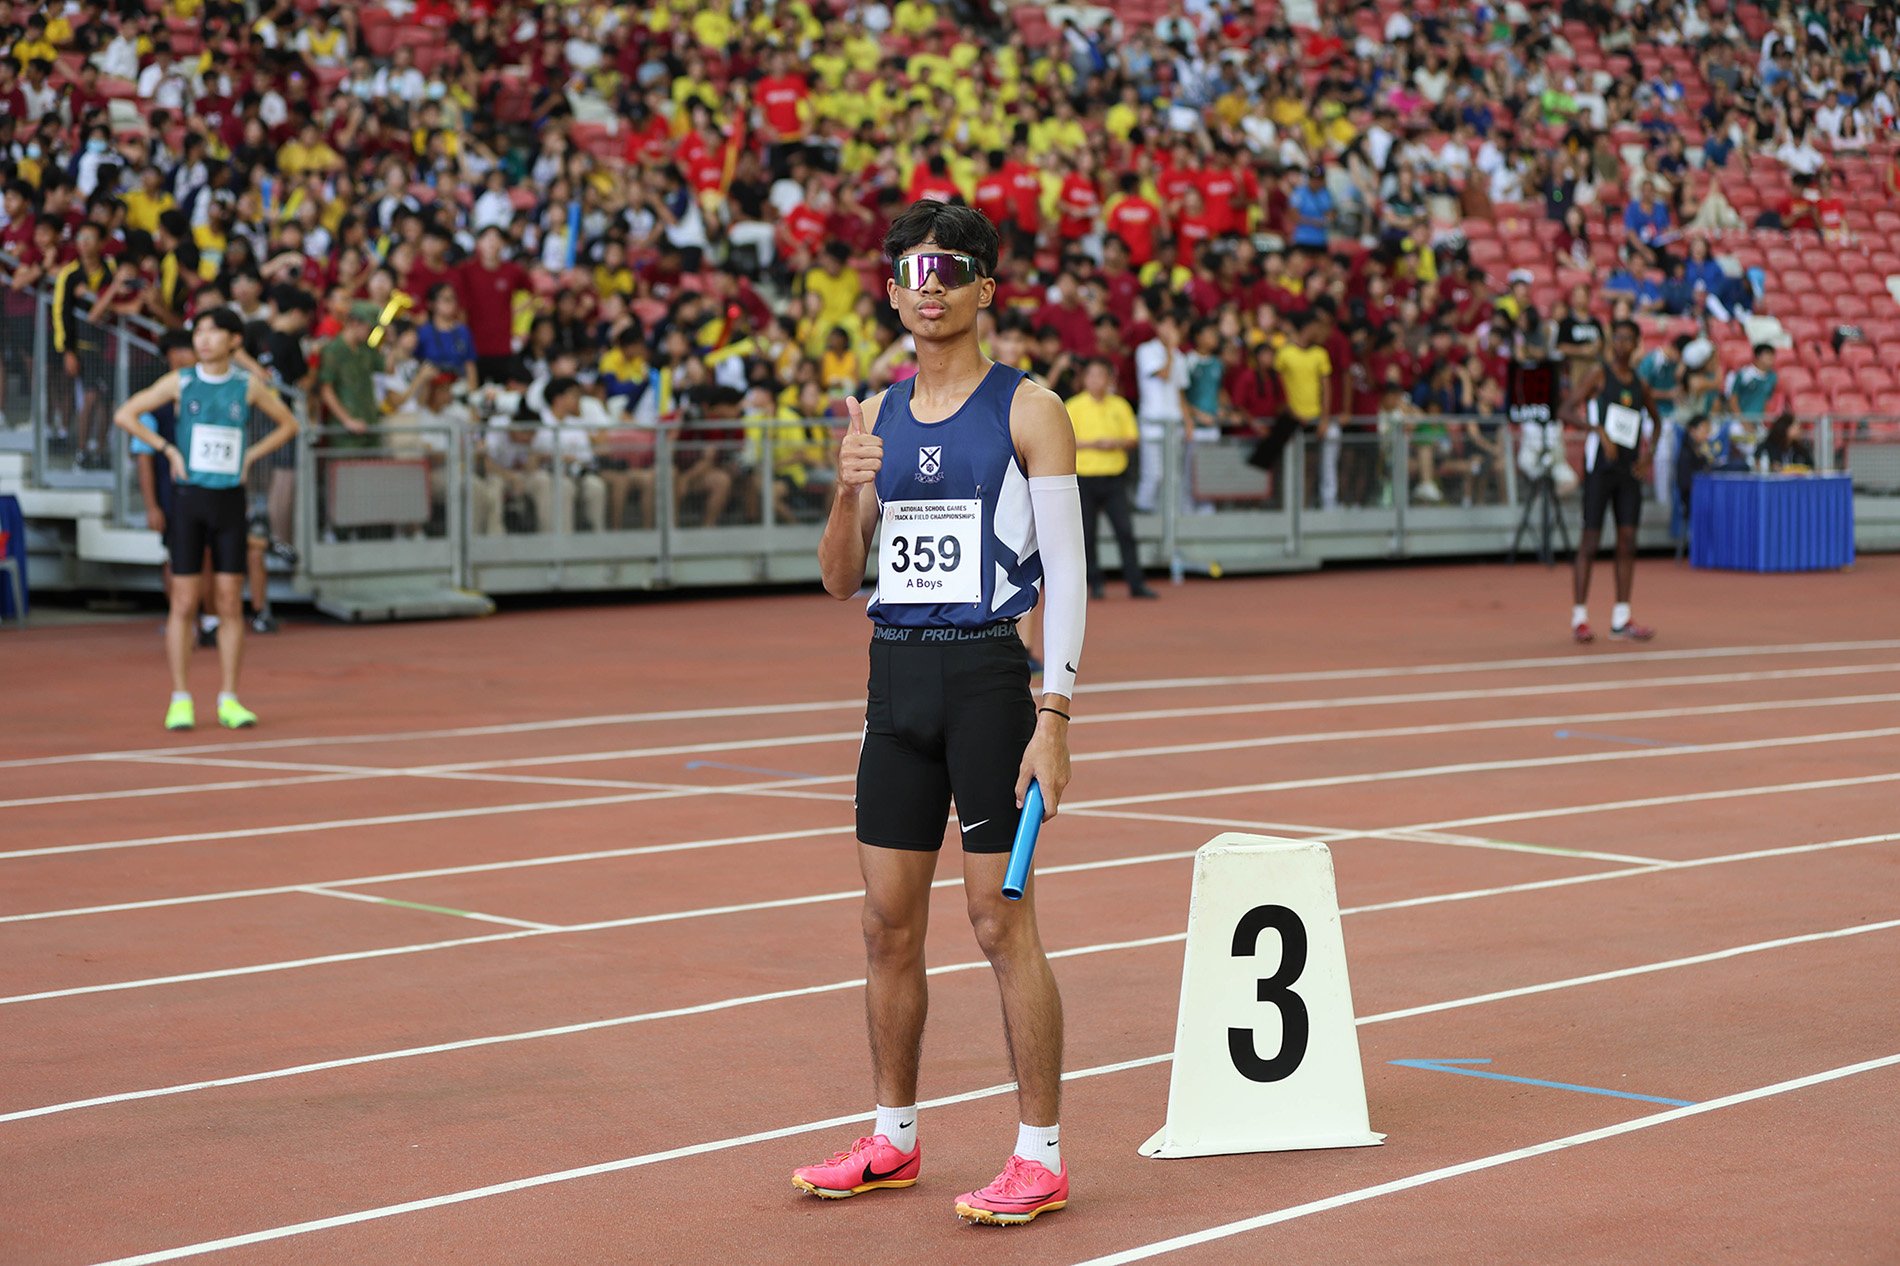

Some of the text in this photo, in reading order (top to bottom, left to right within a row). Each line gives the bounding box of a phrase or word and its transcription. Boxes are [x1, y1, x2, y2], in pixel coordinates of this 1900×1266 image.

[891, 535, 961, 573] 359
[906, 578, 943, 590] A Boys
[1228, 904, 1309, 1083] 3
